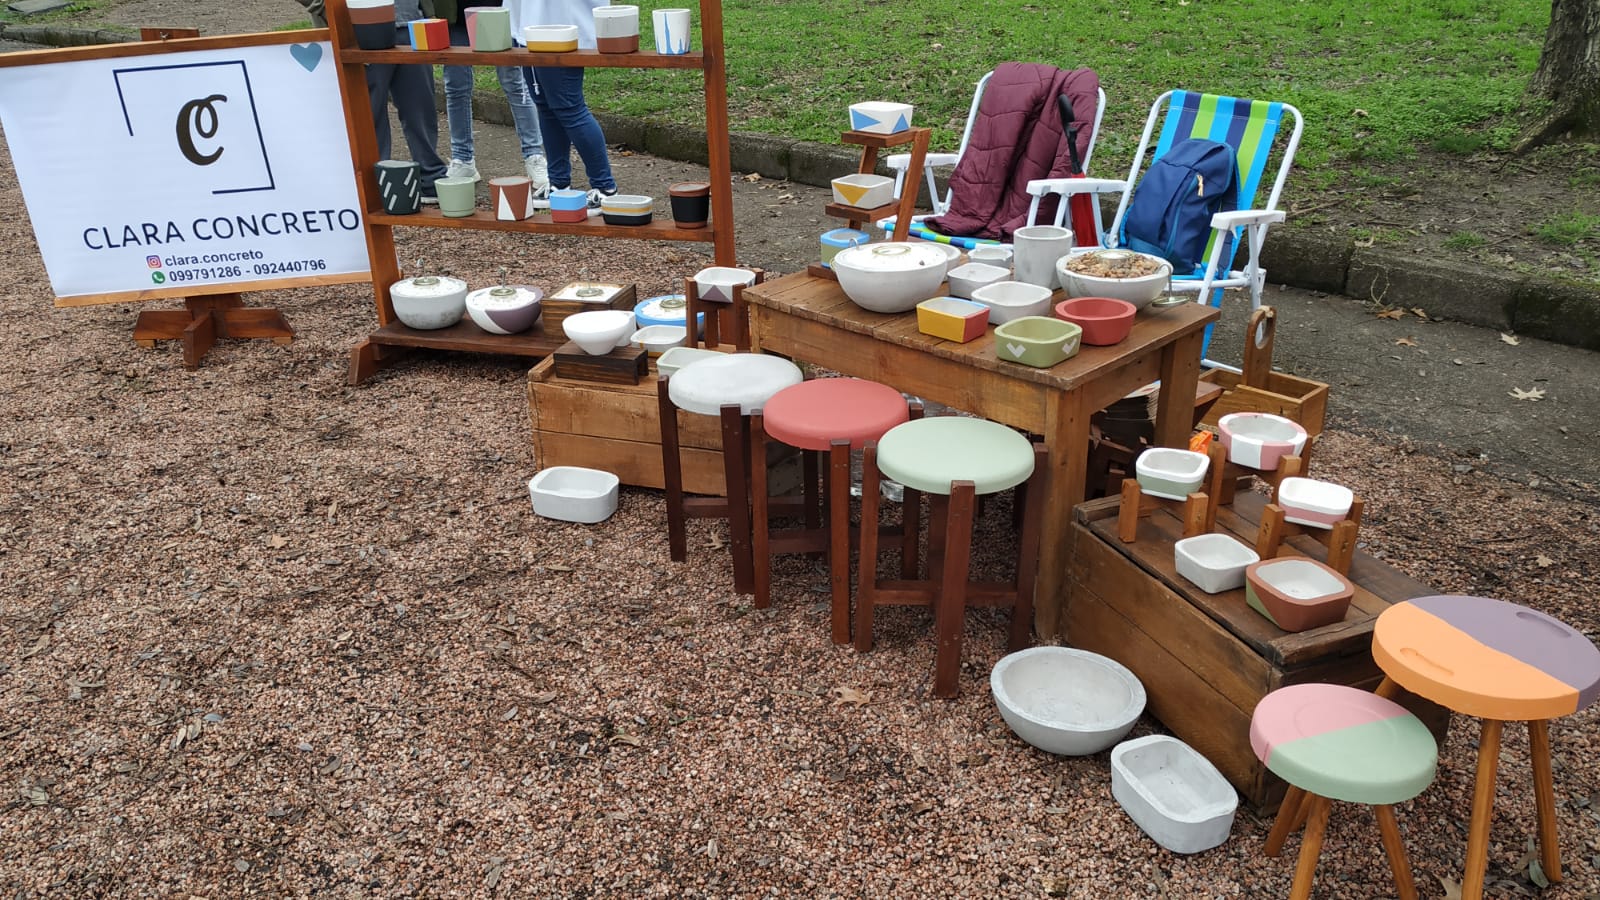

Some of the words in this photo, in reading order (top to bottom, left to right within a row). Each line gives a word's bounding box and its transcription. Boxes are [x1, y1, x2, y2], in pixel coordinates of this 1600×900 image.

[83, 221, 185, 250] CLARA
[192, 209, 359, 240] CONCRETO
[164, 250, 264, 266] clara.concreto
[169, 266, 242, 282] 099791286
[253, 259, 326, 275] 092440796
